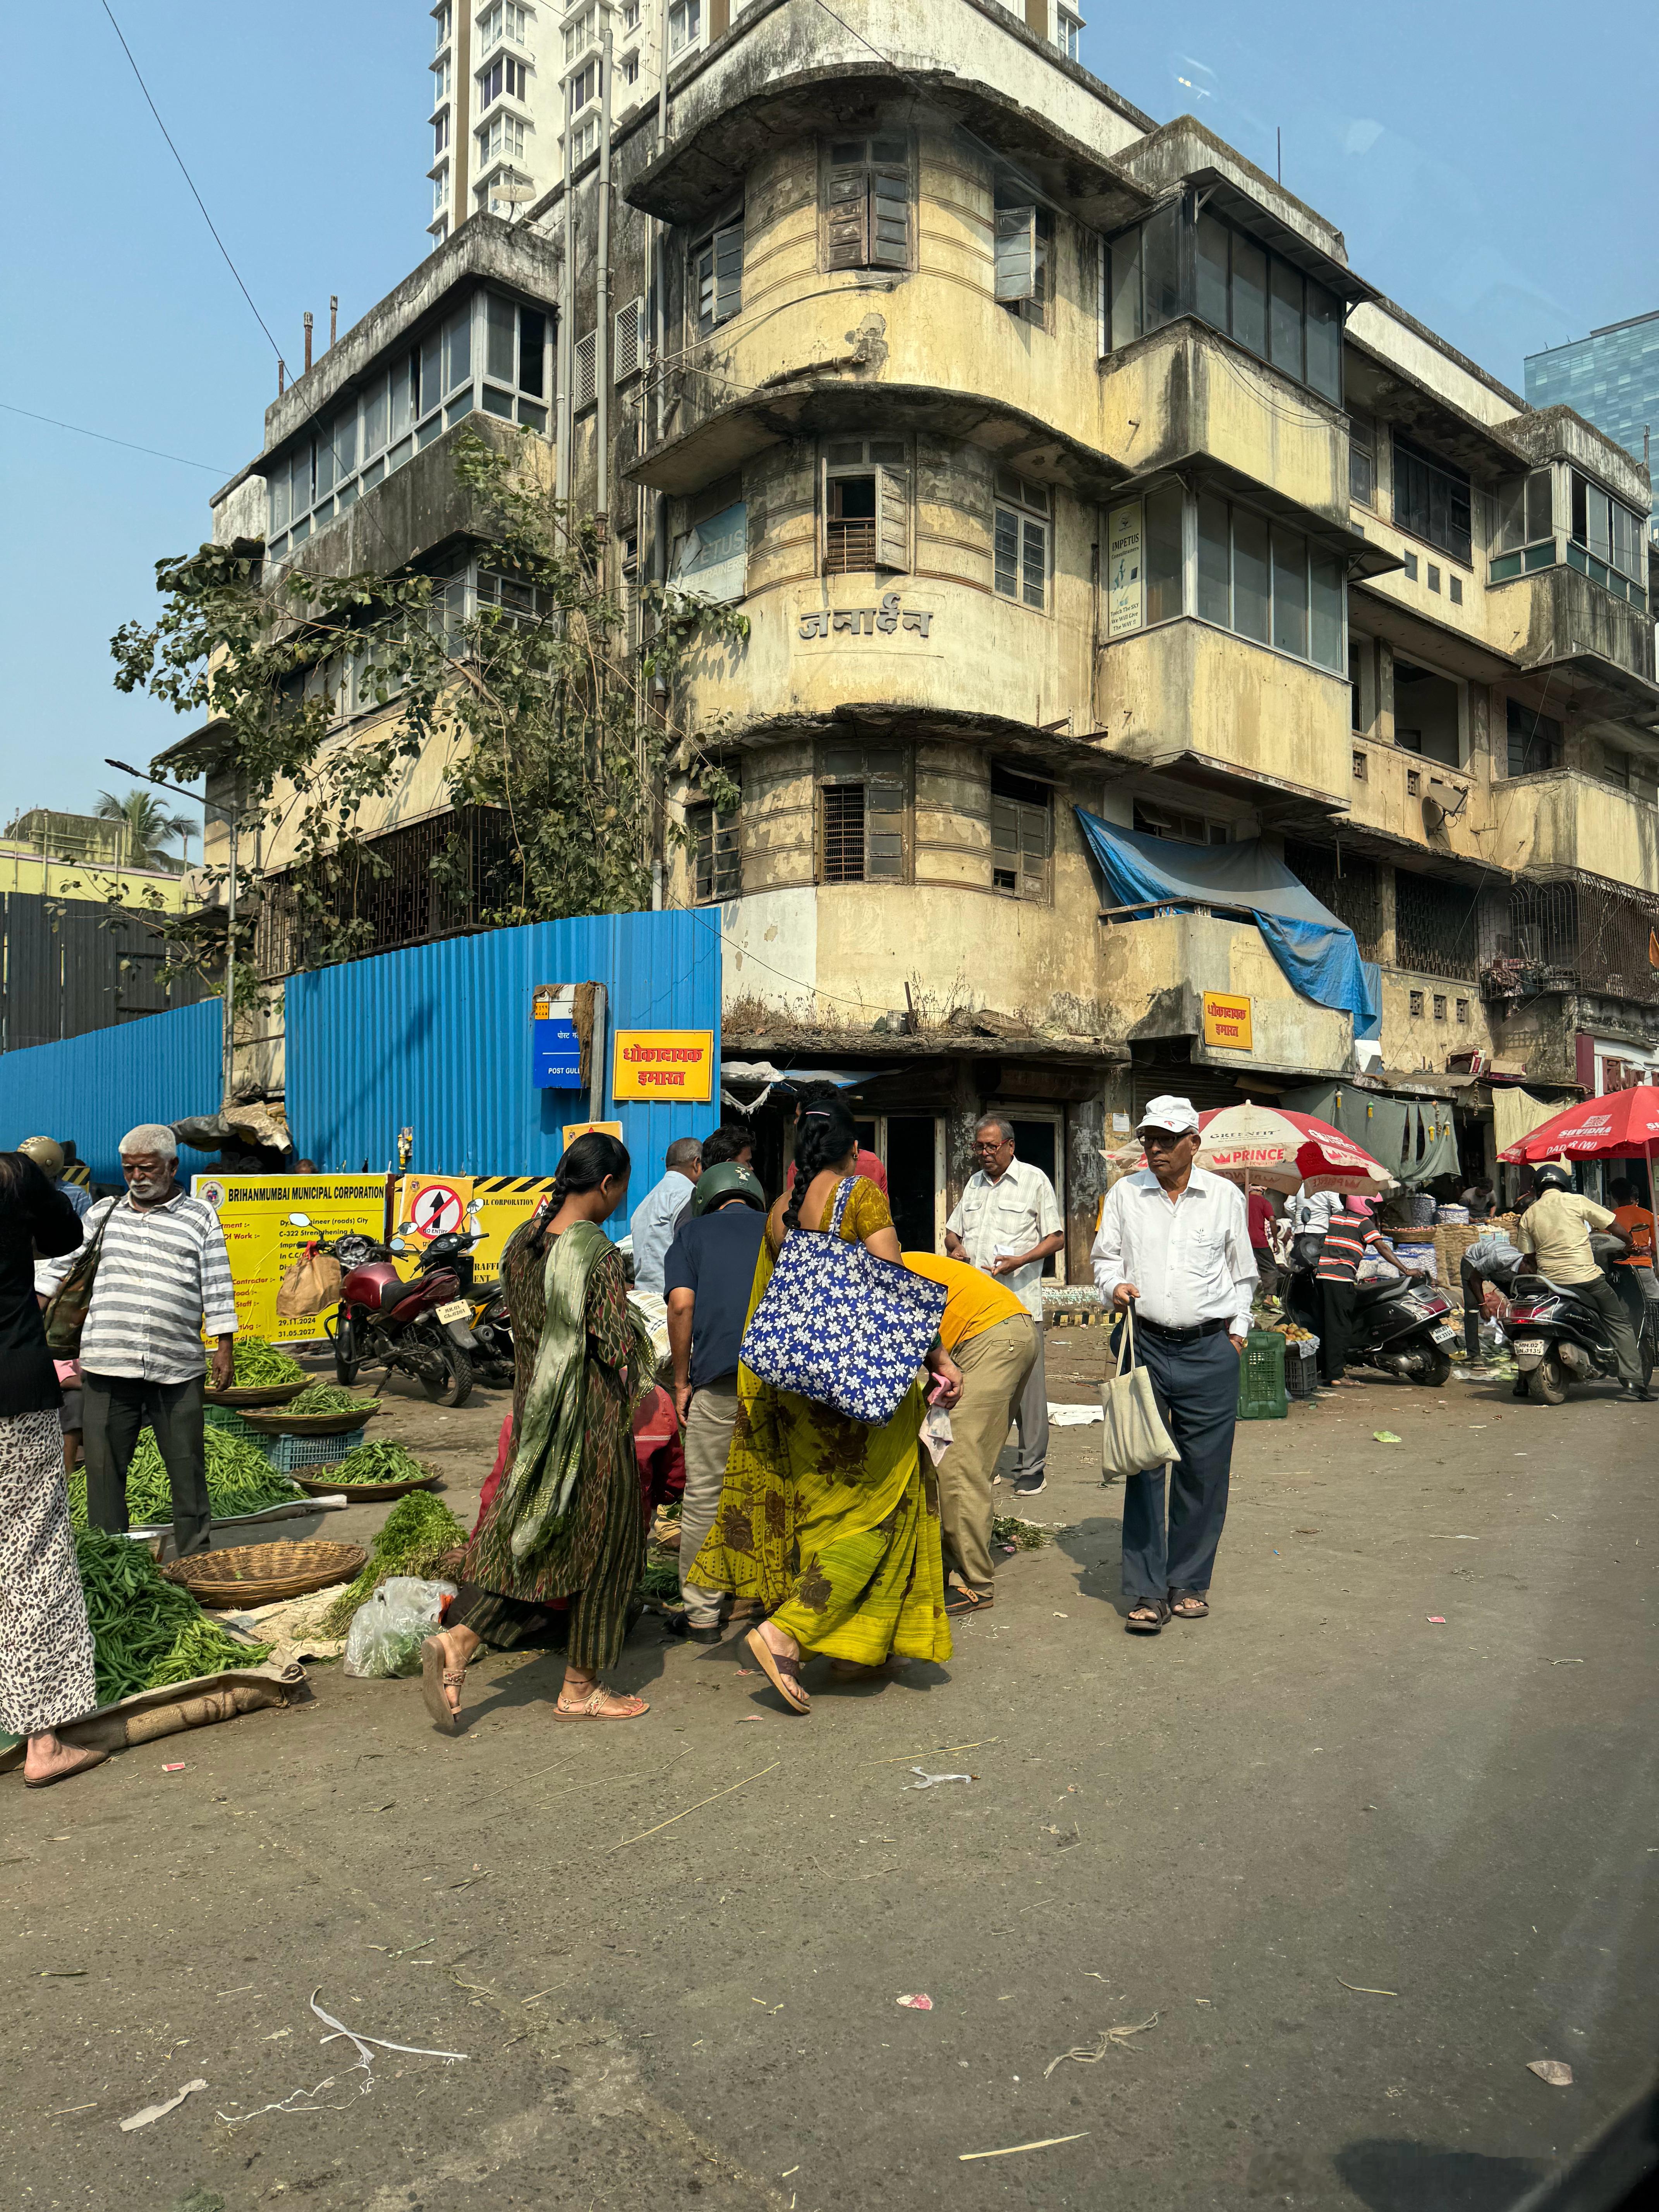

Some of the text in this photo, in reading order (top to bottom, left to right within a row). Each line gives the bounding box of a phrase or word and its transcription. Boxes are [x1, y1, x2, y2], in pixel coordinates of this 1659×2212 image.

[699, 529, 744, 565] ETUS
[1112, 533, 1139, 551] IMPETUS
[799, 592, 934, 639] जनार्दन
[1207, 1002, 1246, 1020] धोकादायक
[557, 1031, 570, 1039] पोस्ट
[1216, 1024, 1238, 1037] इमारत
[623, 1044, 704, 1062] धोकादायक
[638, 1071, 685, 1085] इमारत
[1558, 1127, 1612, 1137] SUVIDHA
[1233, 1149, 1285, 1163] PRINCE
[228, 1186, 384, 1202] BRIHANMUMBAI MUNICIPAL CORPORATION
[474, 1262, 499, 1271] RAFFI
[278, 1317, 315, 1326] 29.11.2024
[278, 1329, 315, 1337] 31.05.2027
